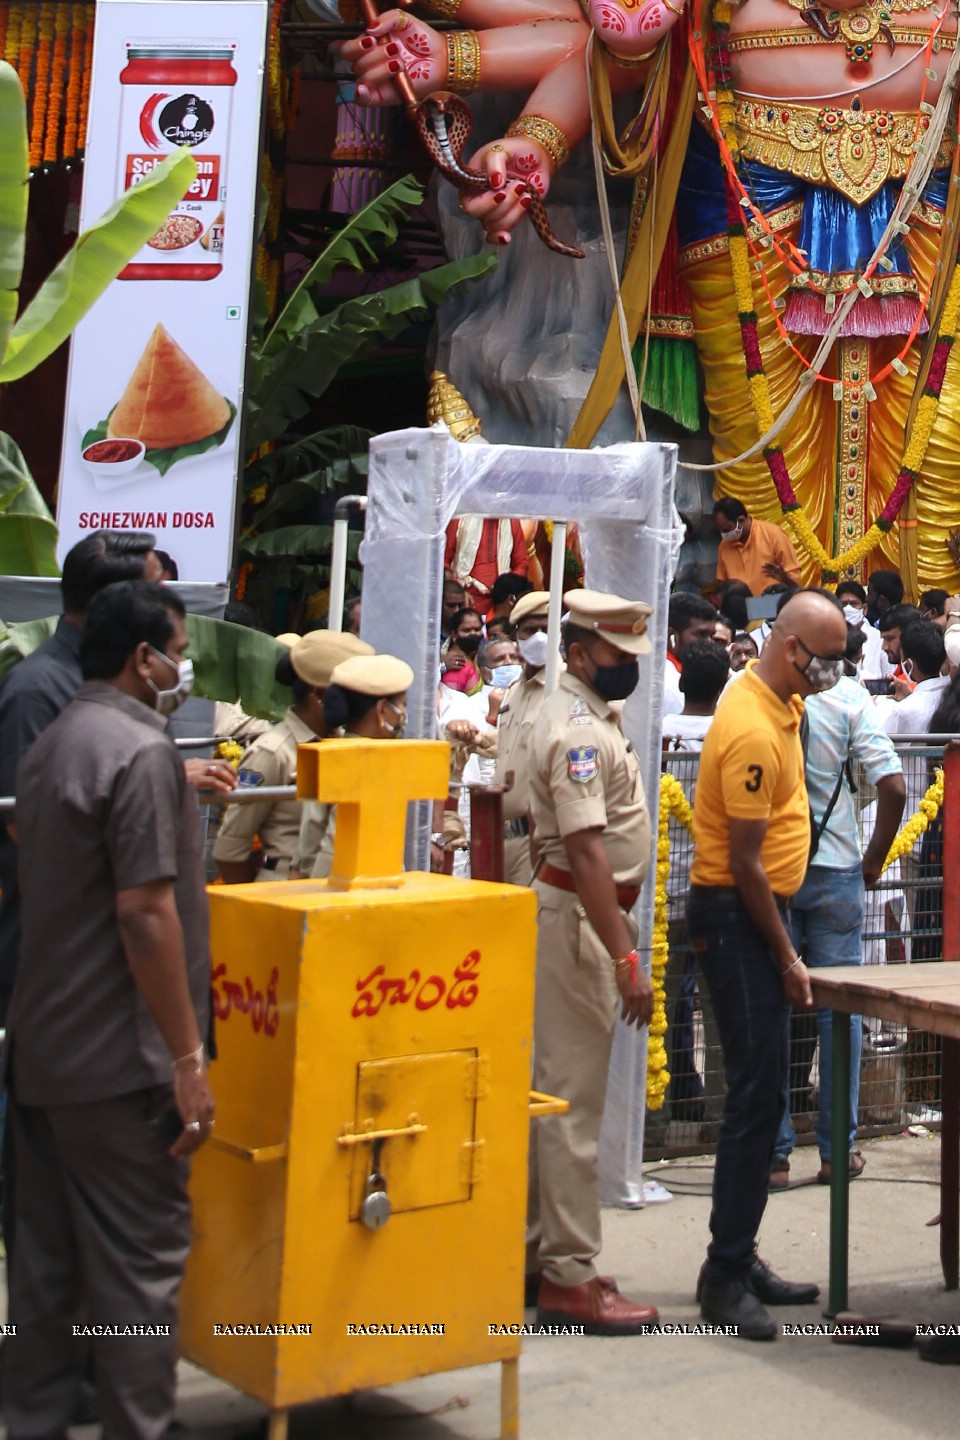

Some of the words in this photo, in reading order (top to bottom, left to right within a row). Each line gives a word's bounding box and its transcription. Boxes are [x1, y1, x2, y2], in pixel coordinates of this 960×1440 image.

[164, 126, 211, 140] Ching's
[79, 512, 167, 529] SCHEZWAN
[172, 512, 215, 529] DOSA
[745, 763, 764, 793] 3
